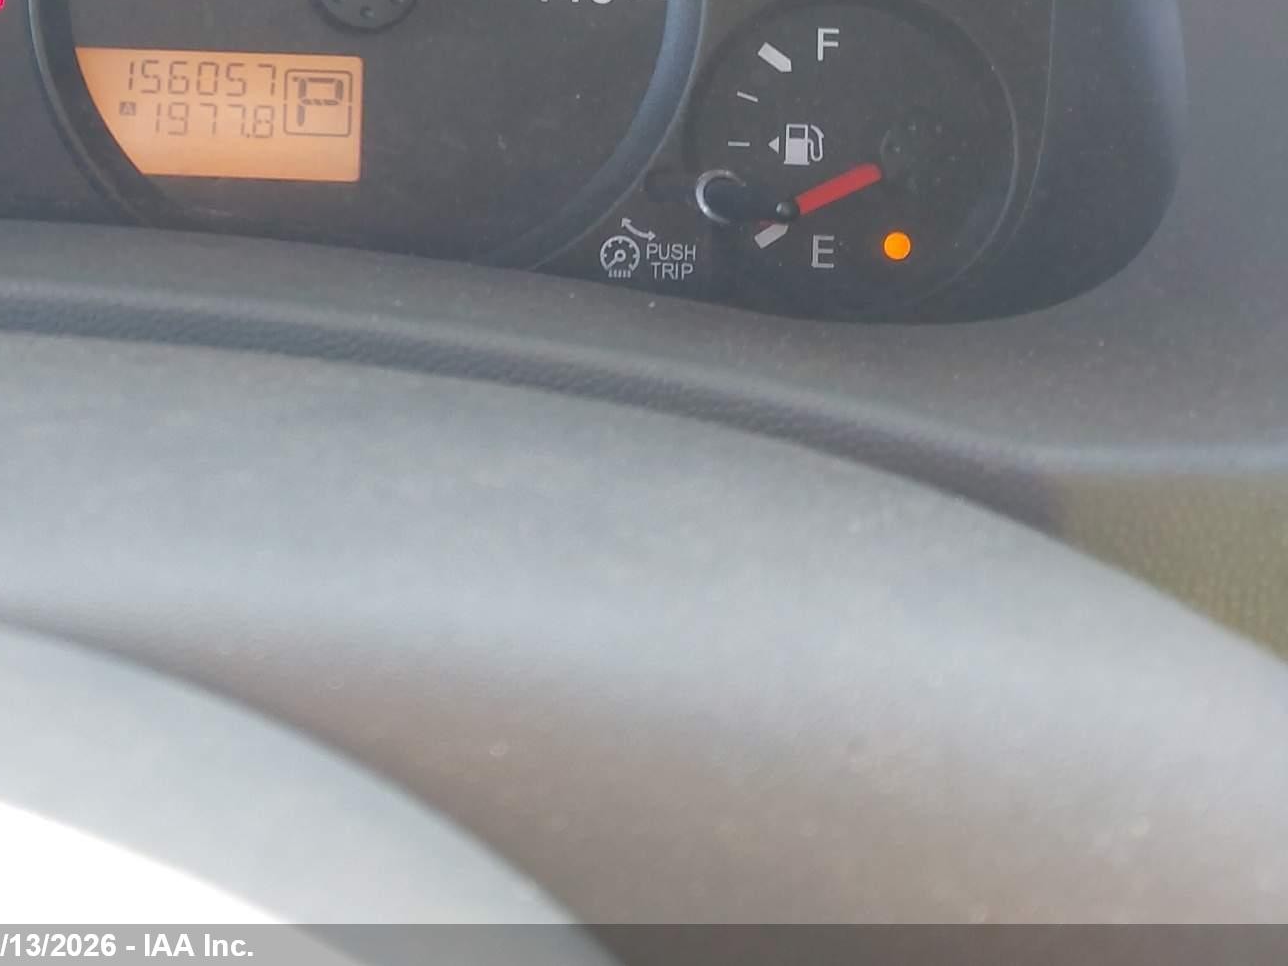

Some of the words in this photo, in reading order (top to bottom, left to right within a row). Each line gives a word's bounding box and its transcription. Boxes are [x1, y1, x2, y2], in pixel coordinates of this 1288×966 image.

[818, 28, 839, 60] F
[127, 60, 276, 97] 156057
[291, 76, 344, 127] P
[647, 244, 695, 262] PUSH
[812, 235, 834, 268] E
[651, 262, 693, 279] TRIP
